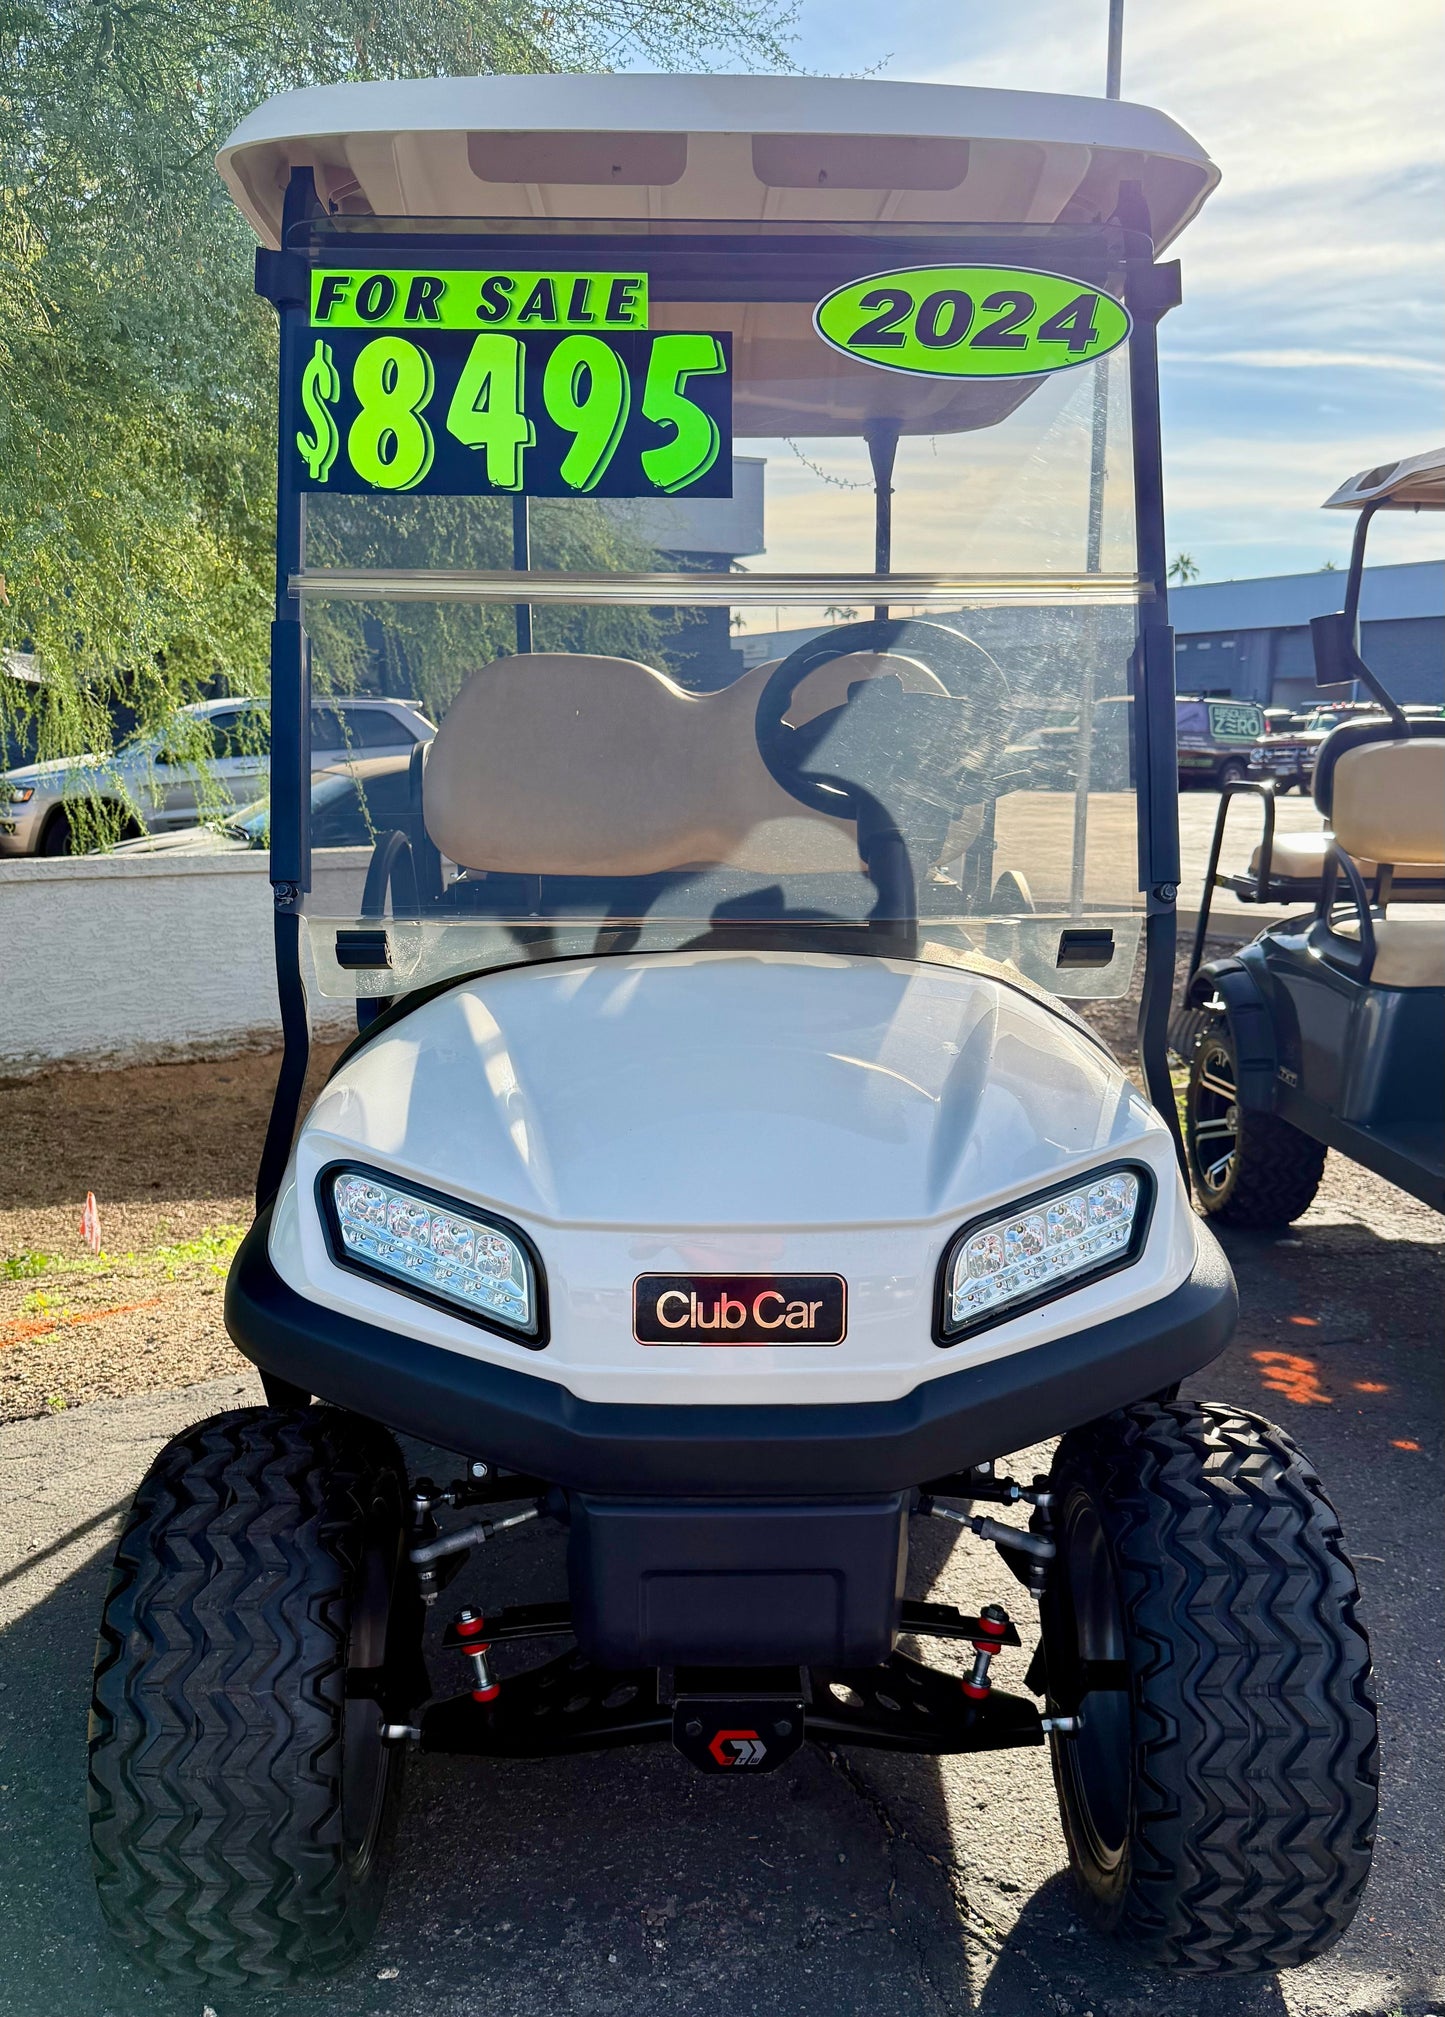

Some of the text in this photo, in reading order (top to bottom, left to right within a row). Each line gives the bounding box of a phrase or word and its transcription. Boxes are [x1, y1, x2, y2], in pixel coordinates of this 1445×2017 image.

[314, 275, 644, 323] FOR SALE
[847, 288, 1101, 354] 2024
[296, 333, 727, 493] $8495
[1215, 717, 1259, 735] ZERO
[656, 1290, 823, 1330] Club Car
